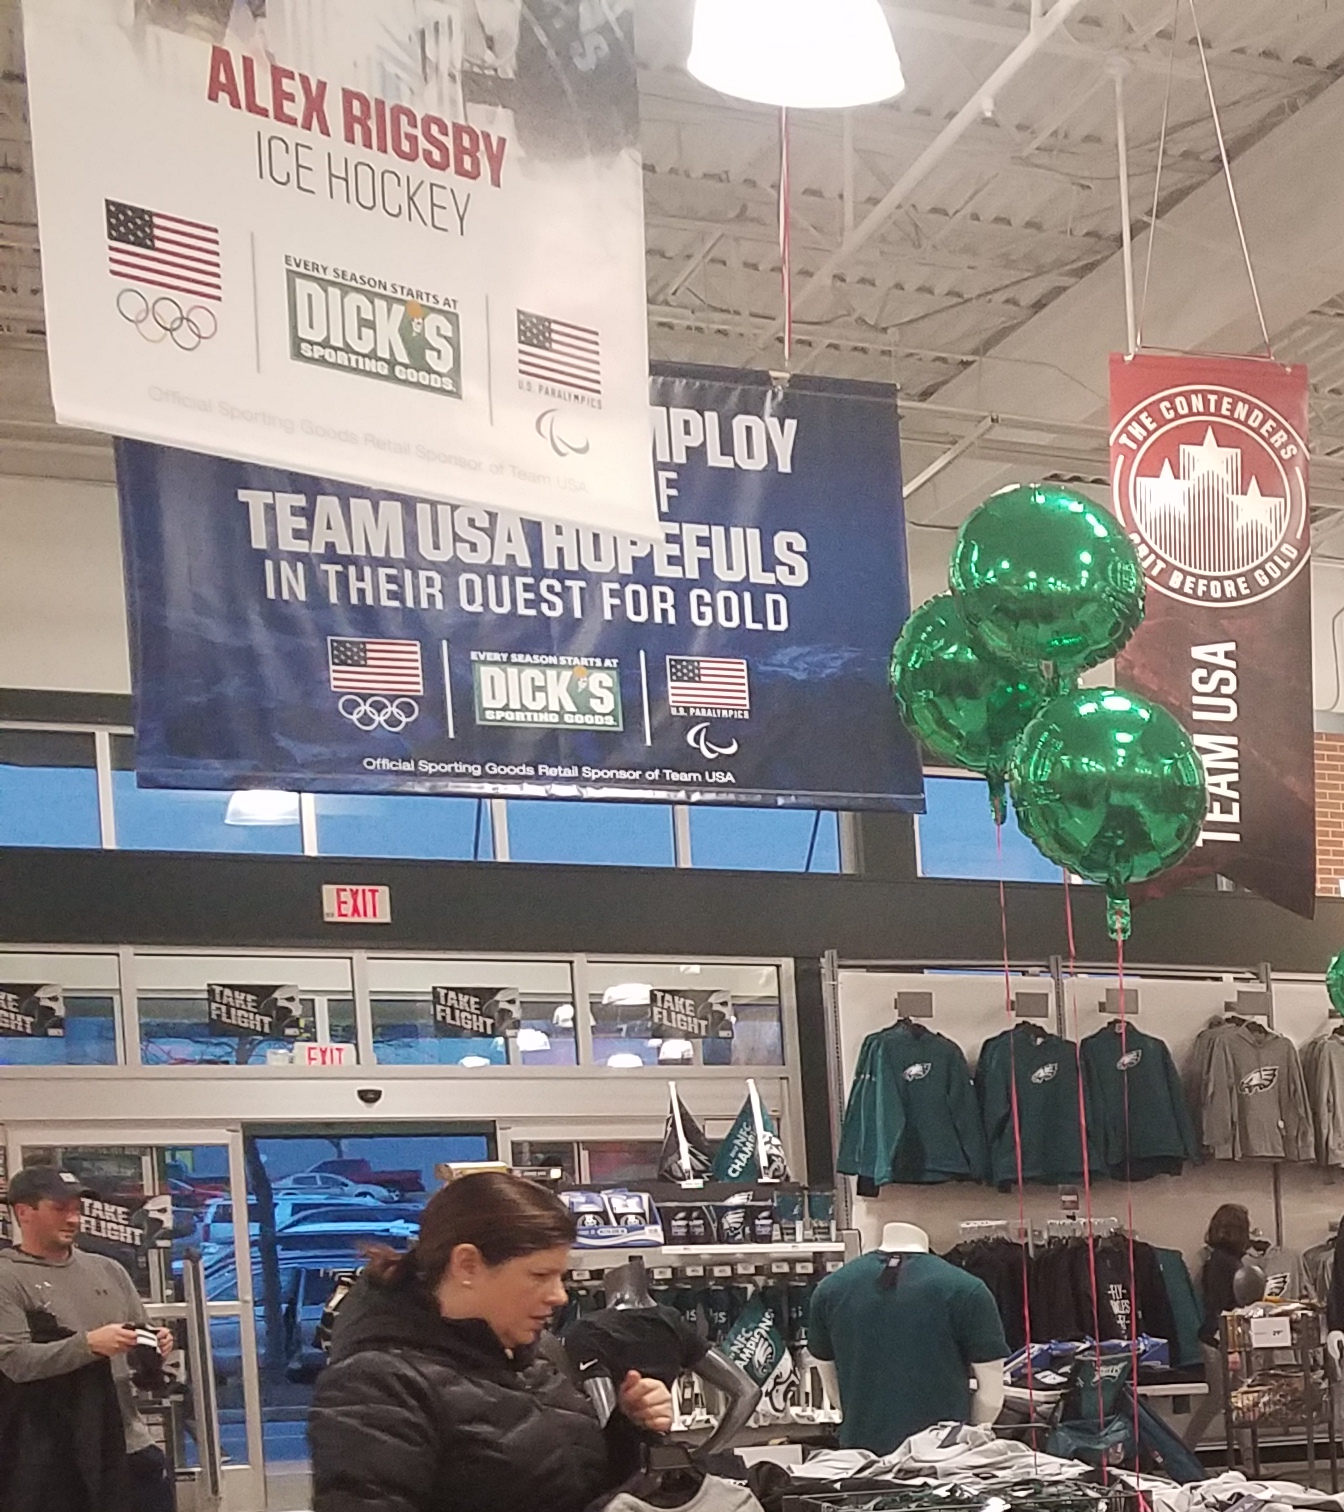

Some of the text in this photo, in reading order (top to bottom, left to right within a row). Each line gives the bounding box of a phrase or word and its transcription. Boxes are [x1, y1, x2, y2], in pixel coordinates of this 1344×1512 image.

[208, 45, 506, 188] ALEX RIGSBY
[257, 131, 470, 236] ICE HOCKEY
[285, 255, 459, 311] EVERY SEASON STARTS AT
[295, 277, 453, 374] DICK'S
[300, 342, 389, 375] SPORTING
[537, 384, 603, 410] PARALYMPICS
[218, 400, 294, 434] Sporting
[300, 417, 358, 445] Goods
[364, 432, 410, 456] Retail
[415, 443, 483, 474] Sponsor
[1118, 393, 1298, 460] THE CONTENDERS
[238, 489, 808, 588] TEAM USA HOPEFULS
[1168, 569, 1251, 599] BEFORE
[1253, 542, 1298, 587] GOLD
[264, 559, 788, 632] IN THEIR QUEST FOR GOLD
[471, 650, 618, 668] EVERY SEASON STARTS AT
[481, 665, 615, 713] DICK'S
[484, 710, 559, 724] SPORTING
[689, 708, 749, 719] PARALYMPICS
[1190, 641, 1241, 847] TEAM USA
[363, 758, 736, 784] Official Sporting Goods Retail Sponsor of Team USA
[336, 888, 379, 918] EXIT
[211, 985, 258, 1013] TAKE
[436, 987, 481, 1014] TAKE
[655, 989, 696, 1017] TAKE
[210, 1003, 273, 1035] FLIGHT
[435, 1003, 496, 1035] FLIGHT
[653, 1005, 709, 1037] FLIGHT
[306, 1046, 345, 1066] EXIT
[733, 1121, 752, 1148] NFC
[80, 1197, 131, 1225] TAKE
[79, 1215, 145, 1246] FLIGHT
[731, 1326, 755, 1353] NFC
[736, 1308, 776, 1371] AMPIONS
